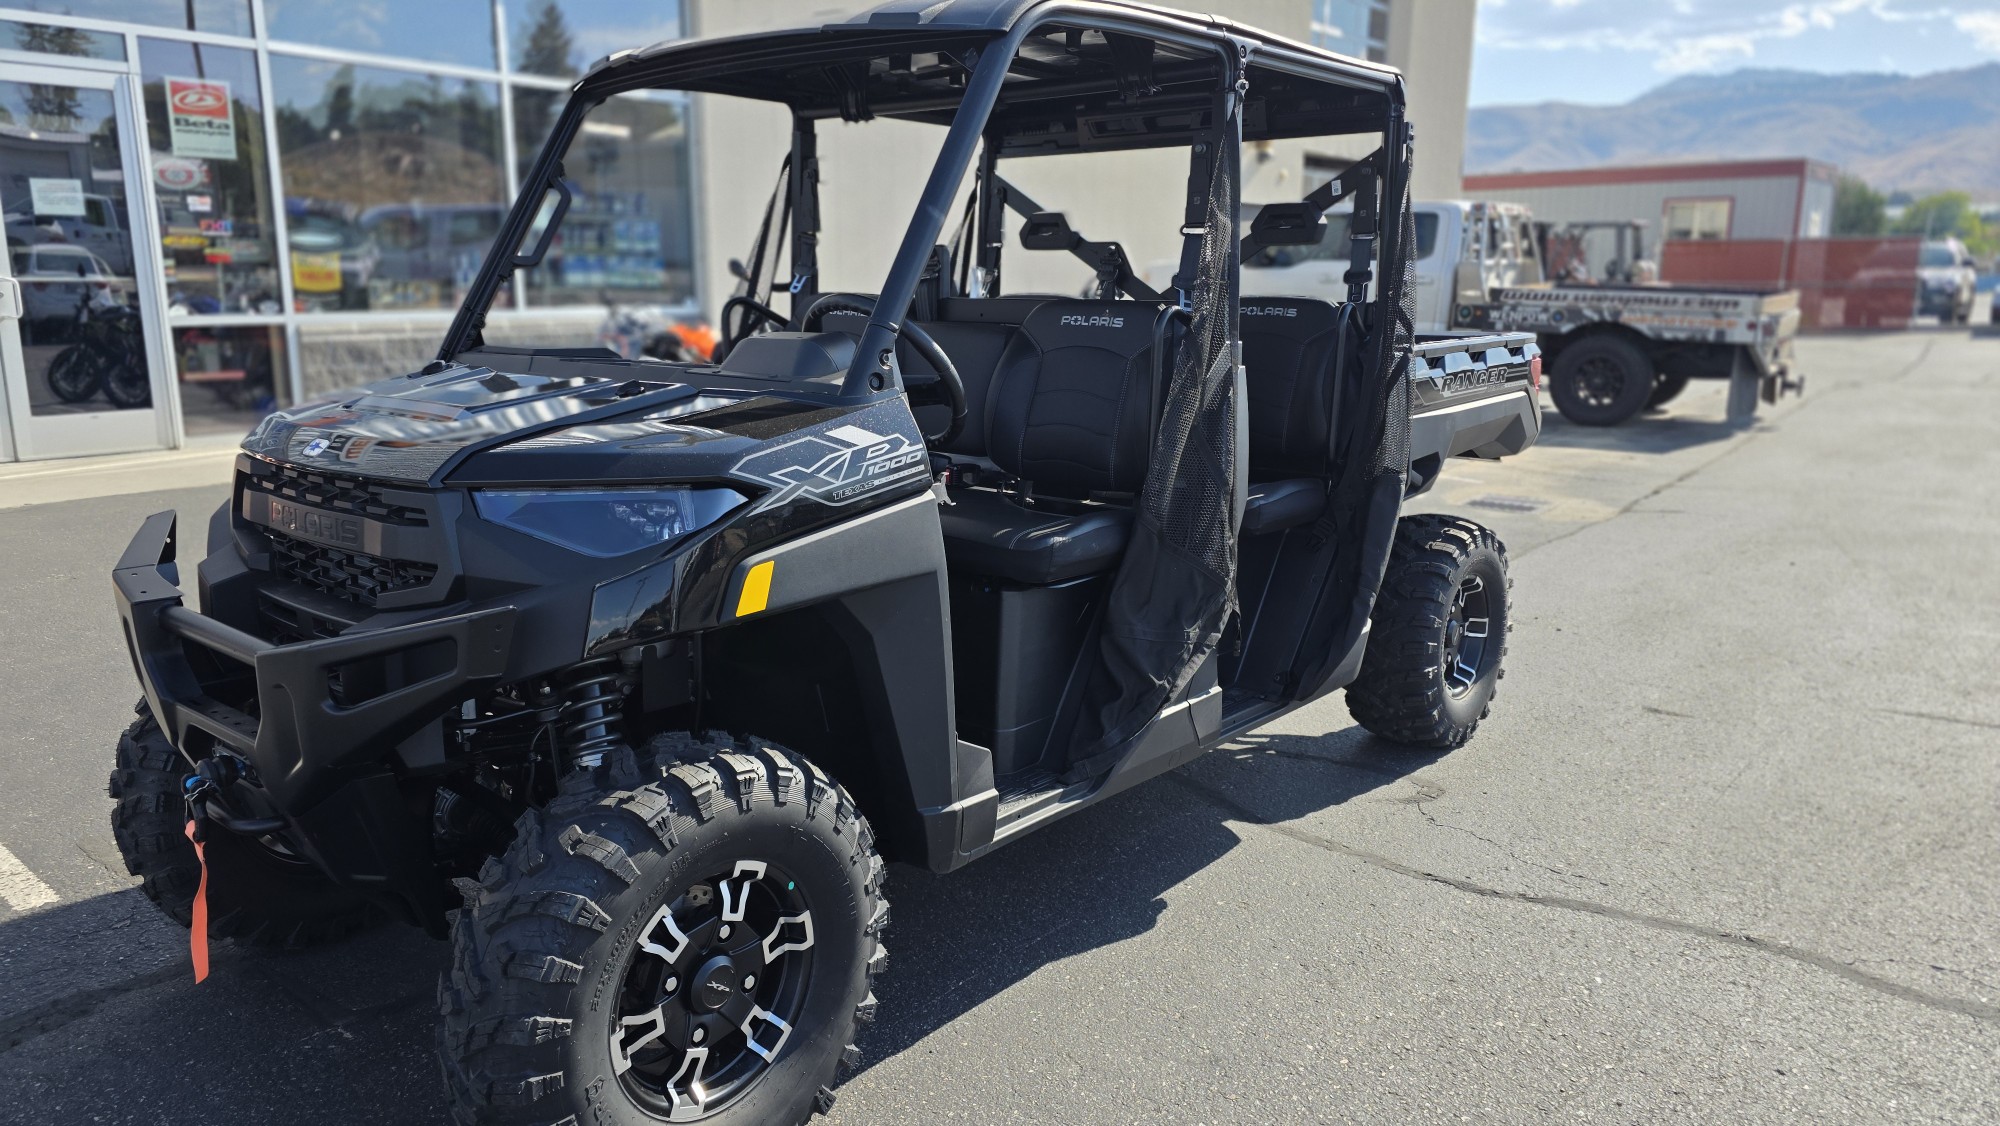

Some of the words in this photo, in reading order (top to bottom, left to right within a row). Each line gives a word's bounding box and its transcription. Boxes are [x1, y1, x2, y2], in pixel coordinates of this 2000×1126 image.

[1060, 315, 1124, 328] POLARIS
[1440, 366, 1508, 394] RANGER
[867, 451, 923, 476] 1000
[832, 480, 876, 500] TEXAS
[271, 500, 361, 547] POLARIS
[706, 980, 730, 992] XP
